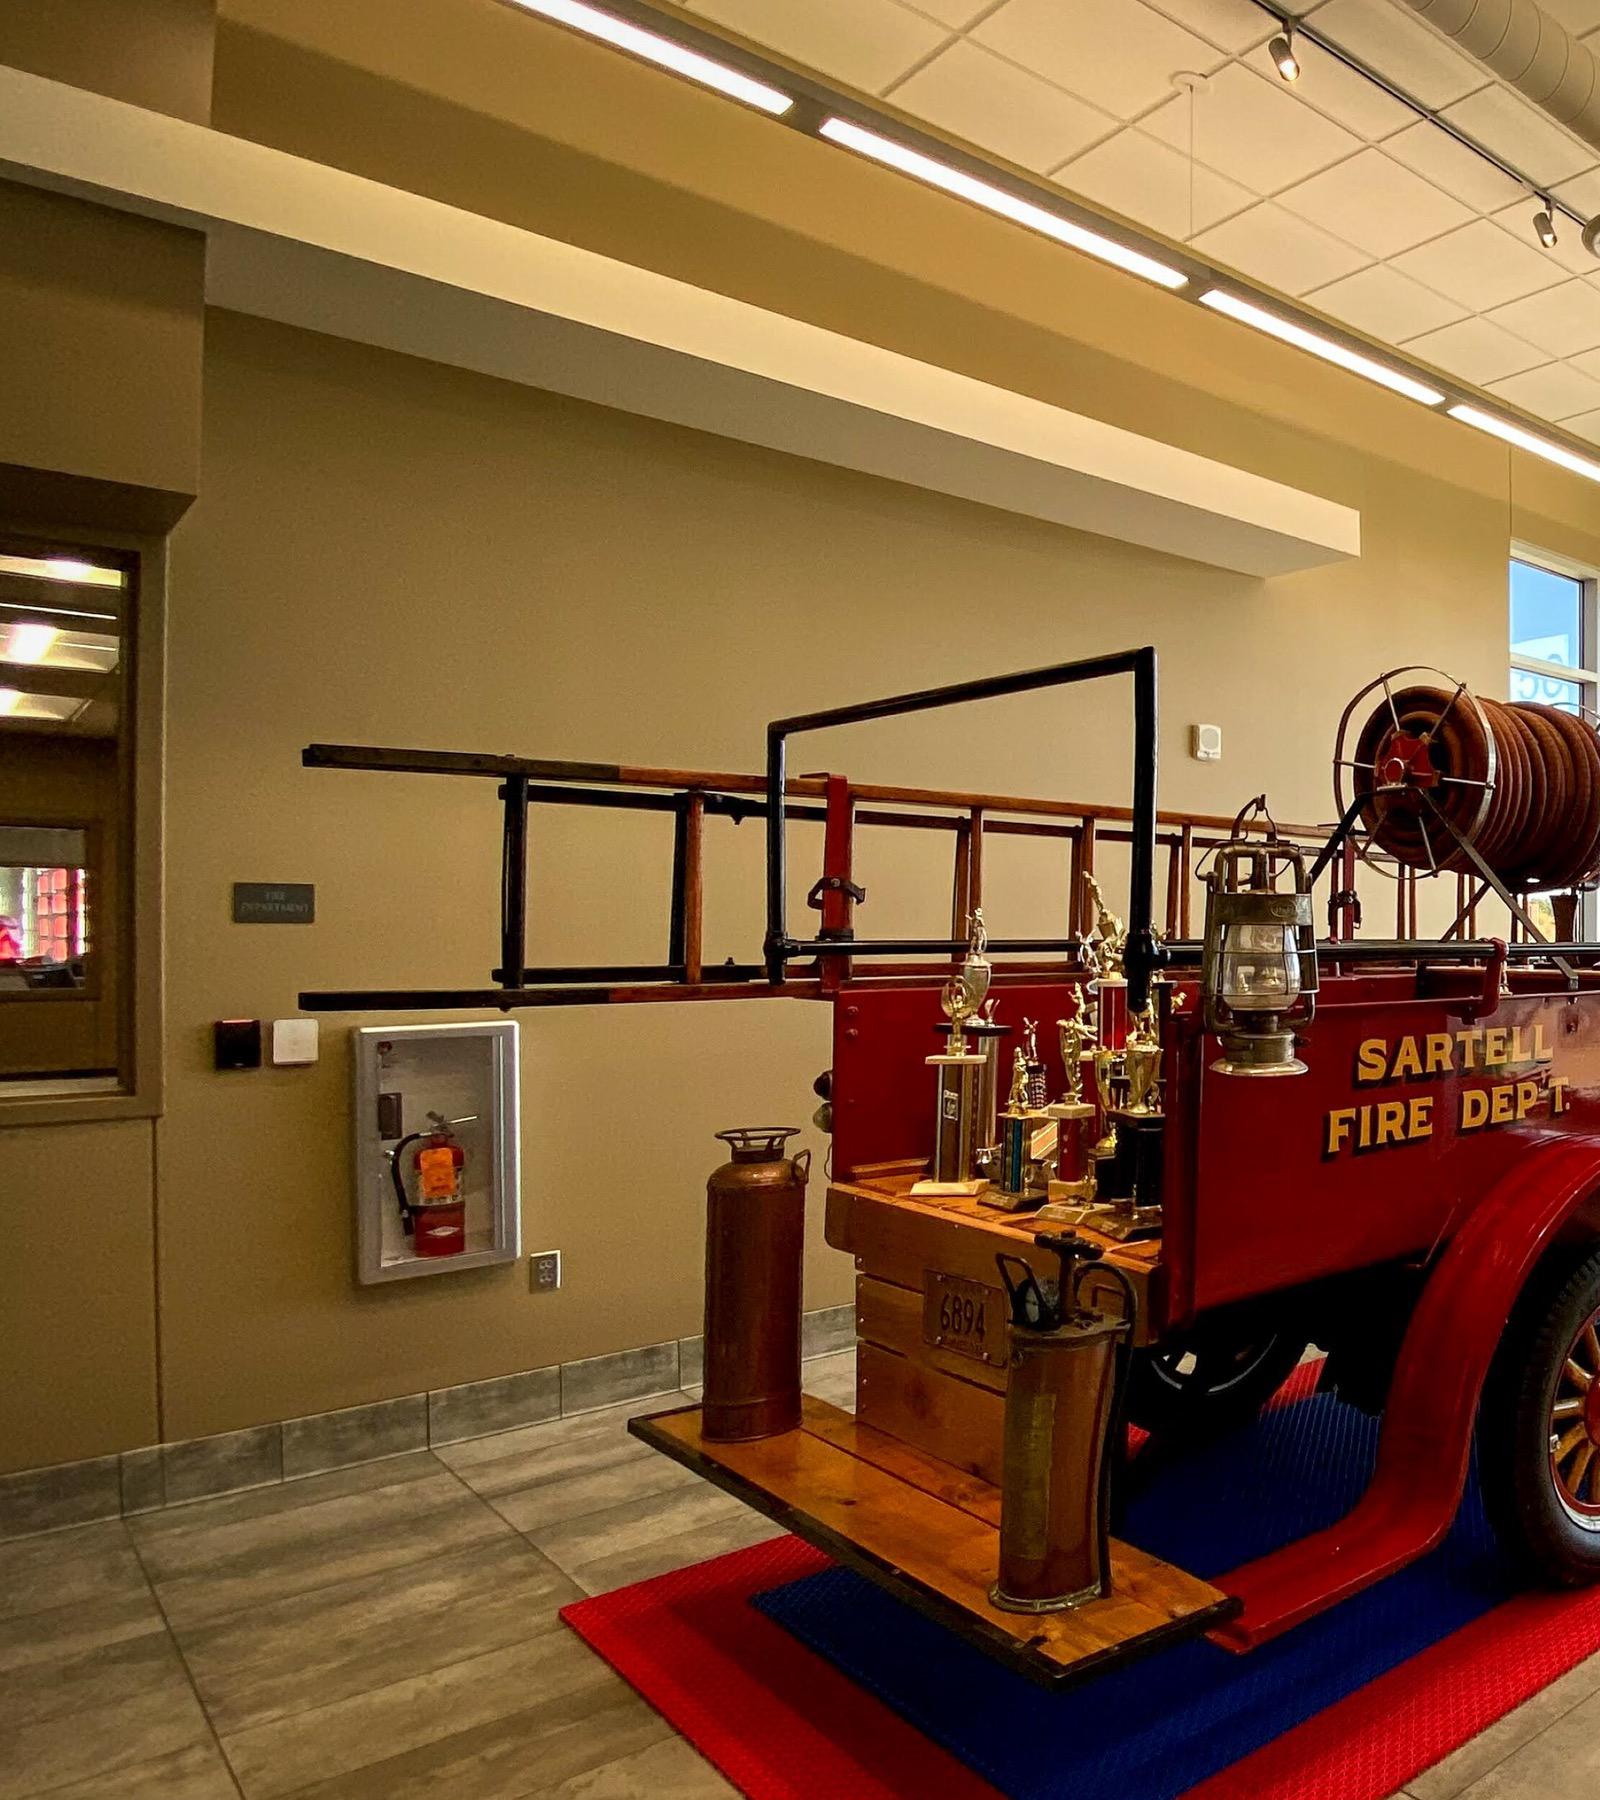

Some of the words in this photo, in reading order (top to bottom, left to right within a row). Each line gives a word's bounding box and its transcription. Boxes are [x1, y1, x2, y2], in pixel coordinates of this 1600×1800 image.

[1358, 1024, 1554, 1081] SARTELL
[1328, 1096, 1434, 1153] FIRE
[940, 1293, 986, 1342] 6894
